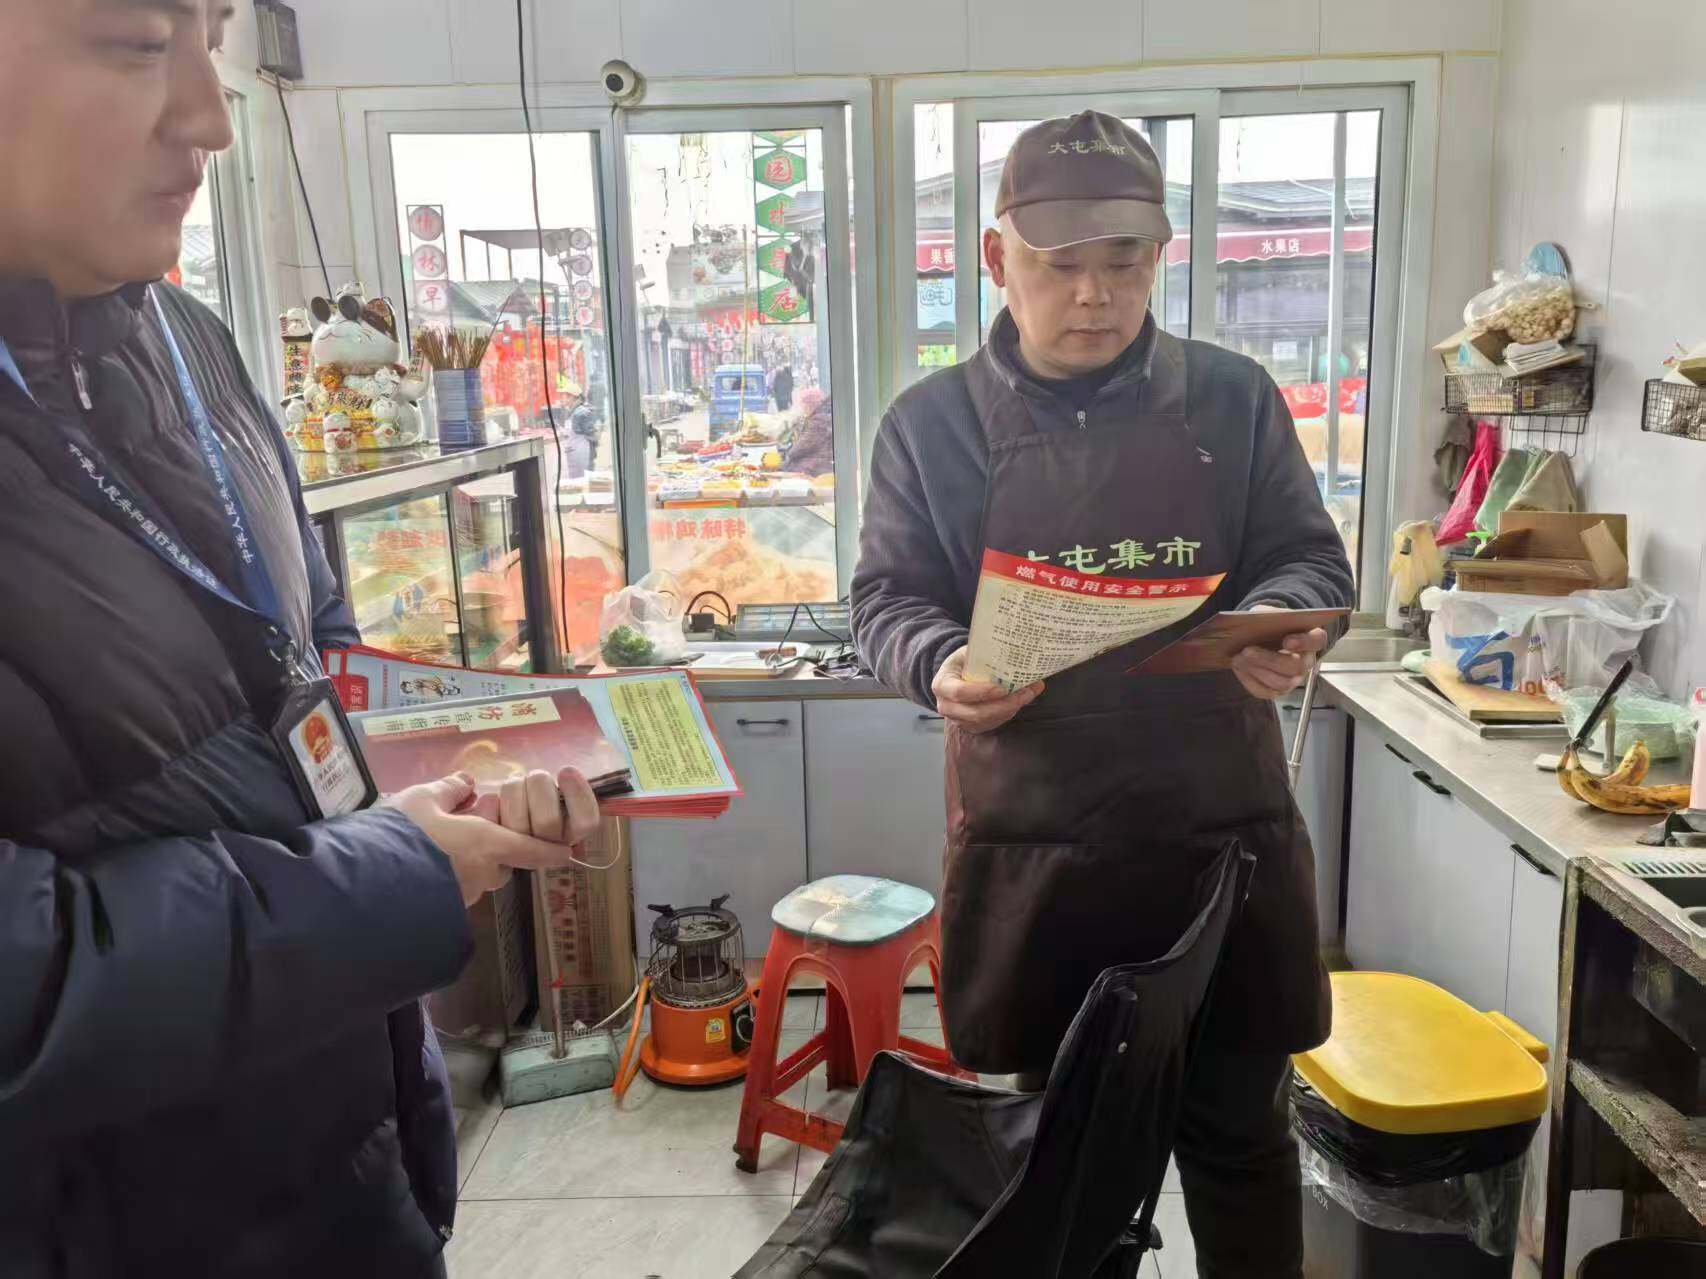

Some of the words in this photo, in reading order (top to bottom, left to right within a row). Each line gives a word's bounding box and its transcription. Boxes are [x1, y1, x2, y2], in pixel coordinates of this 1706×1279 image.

[1261, 239, 1301, 254] 水果店
[1015, 564, 1190, 596] 燃气使用安全警示
